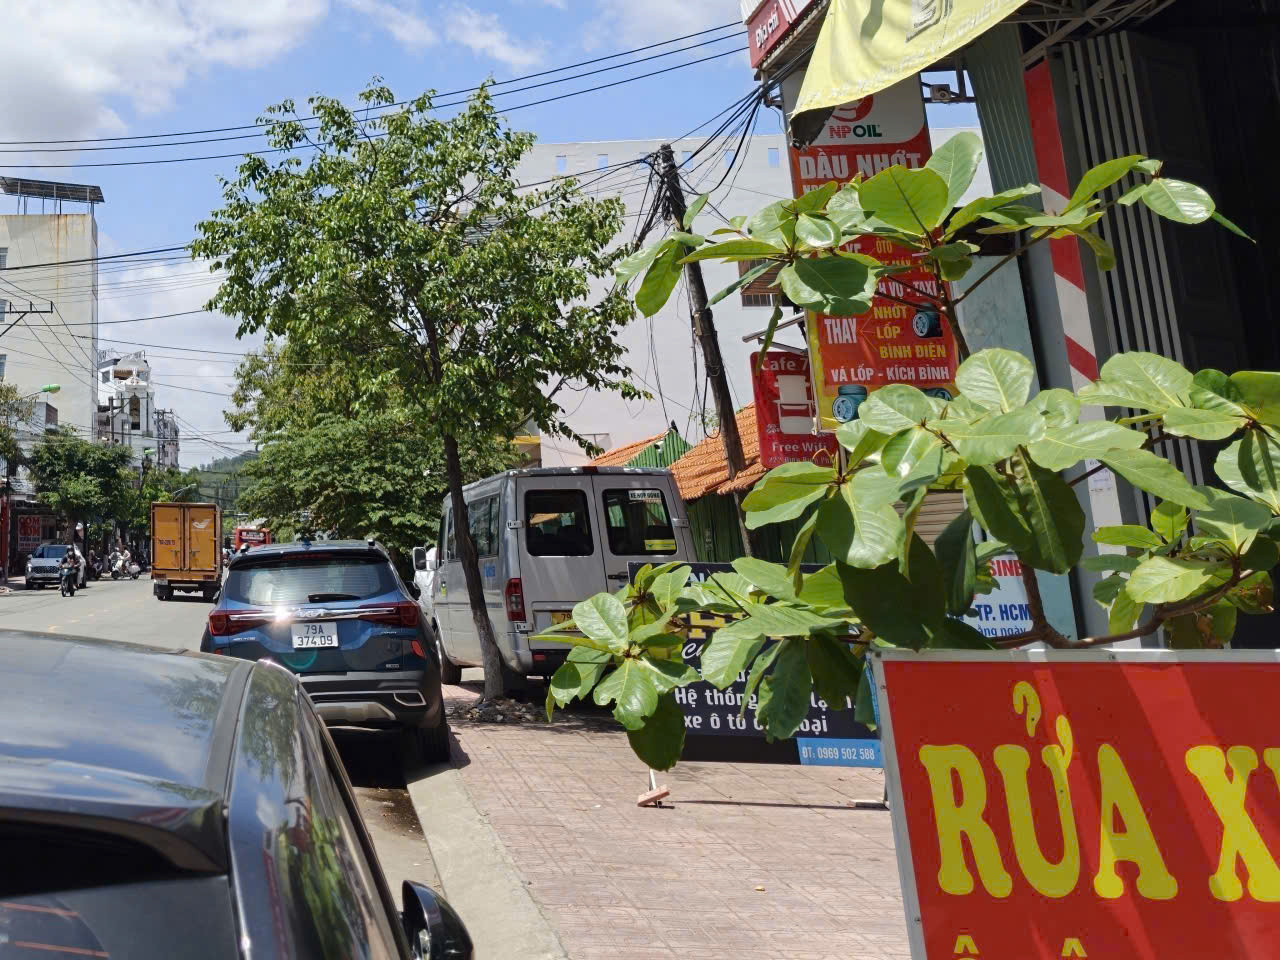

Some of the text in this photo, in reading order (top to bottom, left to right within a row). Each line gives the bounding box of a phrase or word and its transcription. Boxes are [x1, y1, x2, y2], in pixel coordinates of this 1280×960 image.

[799, 148, 849, 180] DẦU
[824, 318, 902, 344] THAY LỐP
[879, 342, 947, 361] BÌNH ĐIỆN
[850, 363, 875, 381] LỐP
[886, 364, 918, 381] KÍCH
[919, 364, 950, 380] BÌNH
[772, 442, 800, 452] Free
[975, 604, 996, 622] TP.
[998, 603, 1033, 621] HCM
[303, 624, 324, 636] 79A
[297, 635, 334, 647] 374.09
[674, 687, 698, 708] Hệ
[704, 686, 758, 710] thống
[684, 715, 703, 729] xe
[710, 713, 721, 729] ô
[726, 713, 747, 730] tô
[817, 746, 839, 760] 0969
[841, 748, 858, 760] 502
[859, 749, 876, 761] 588
[919, 680, 1280, 903] RỬA X
